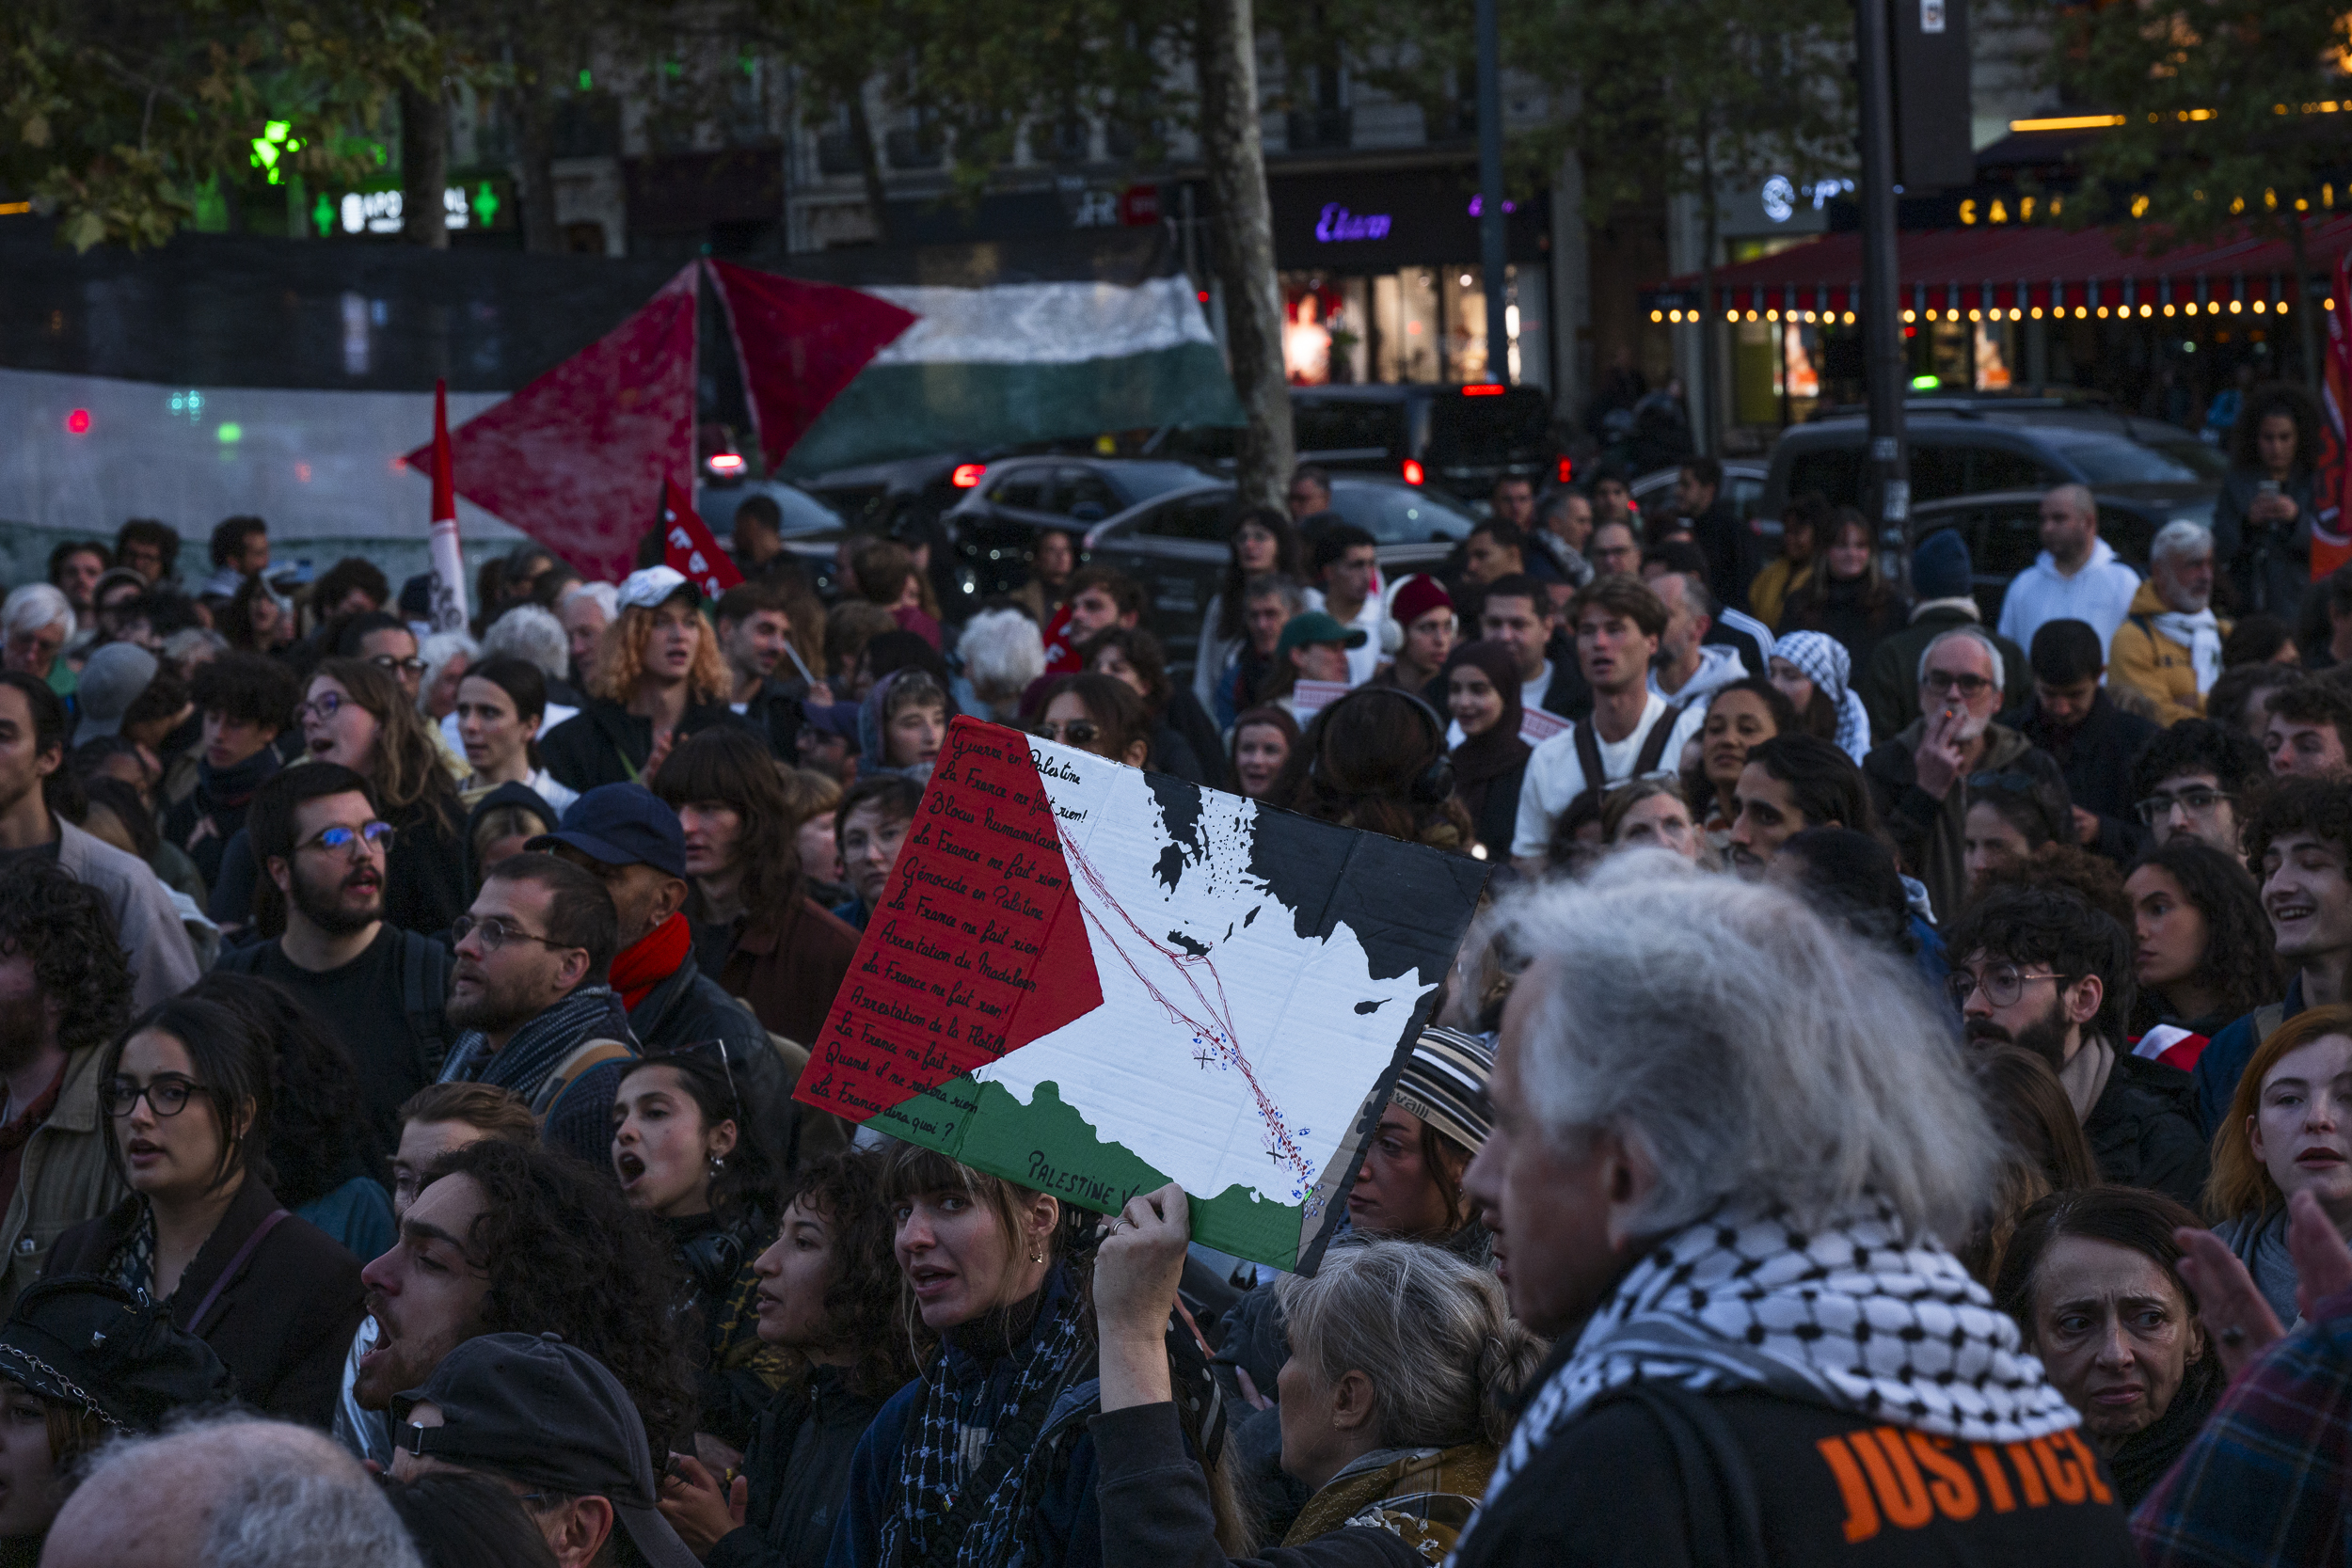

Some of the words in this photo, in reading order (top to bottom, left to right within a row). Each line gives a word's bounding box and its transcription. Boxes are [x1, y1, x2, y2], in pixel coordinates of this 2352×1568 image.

[939, 761, 958, 782] La
[965, 768, 1007, 799] France
[1029, 789, 1055, 816] fait
[1008, 753, 1022, 767] en
[1026, 749, 1081, 785] Palestine
[914, 822, 931, 846] La
[936, 829, 980, 863] France
[1004, 853, 1036, 879] fait
[929, 791, 975, 823] Blocus
[984, 807, 1063, 854] humanitaire
[887, 888, 908, 911] La
[915, 895, 956, 927] France
[979, 920, 1009, 944] fait
[903, 856, 968, 895] Génocide
[972, 888, 986, 901] en
[993, 886, 1043, 921] Palestine
[880, 920, 952, 963] Arrestation
[954, 950, 972, 970] du
[862, 951, 879, 974] La
[884, 960, 927, 991] France
[946, 980, 975, 1007] fait
[850, 986, 926, 1027] Arrestation
[928, 1017, 943, 1033] de
[947, 1017, 959, 1038] la
[834, 1011, 852, 1037] La
[861, 1023, 898, 1054] France
[921, 1041, 948, 1070] fait
[810, 1073, 831, 1099] La
[838, 1081, 882, 1114] France
[883, 1103, 910, 1124] dira
[912, 1117, 937, 1134] quoi
[826, 1041, 871, 1071] Quand
[876, 1061, 891, 1078] il
[907, 1076, 947, 1102] restera
[950, 1095, 978, 1114] rien
[1028, 1149, 1116, 1205] PALESTINE
